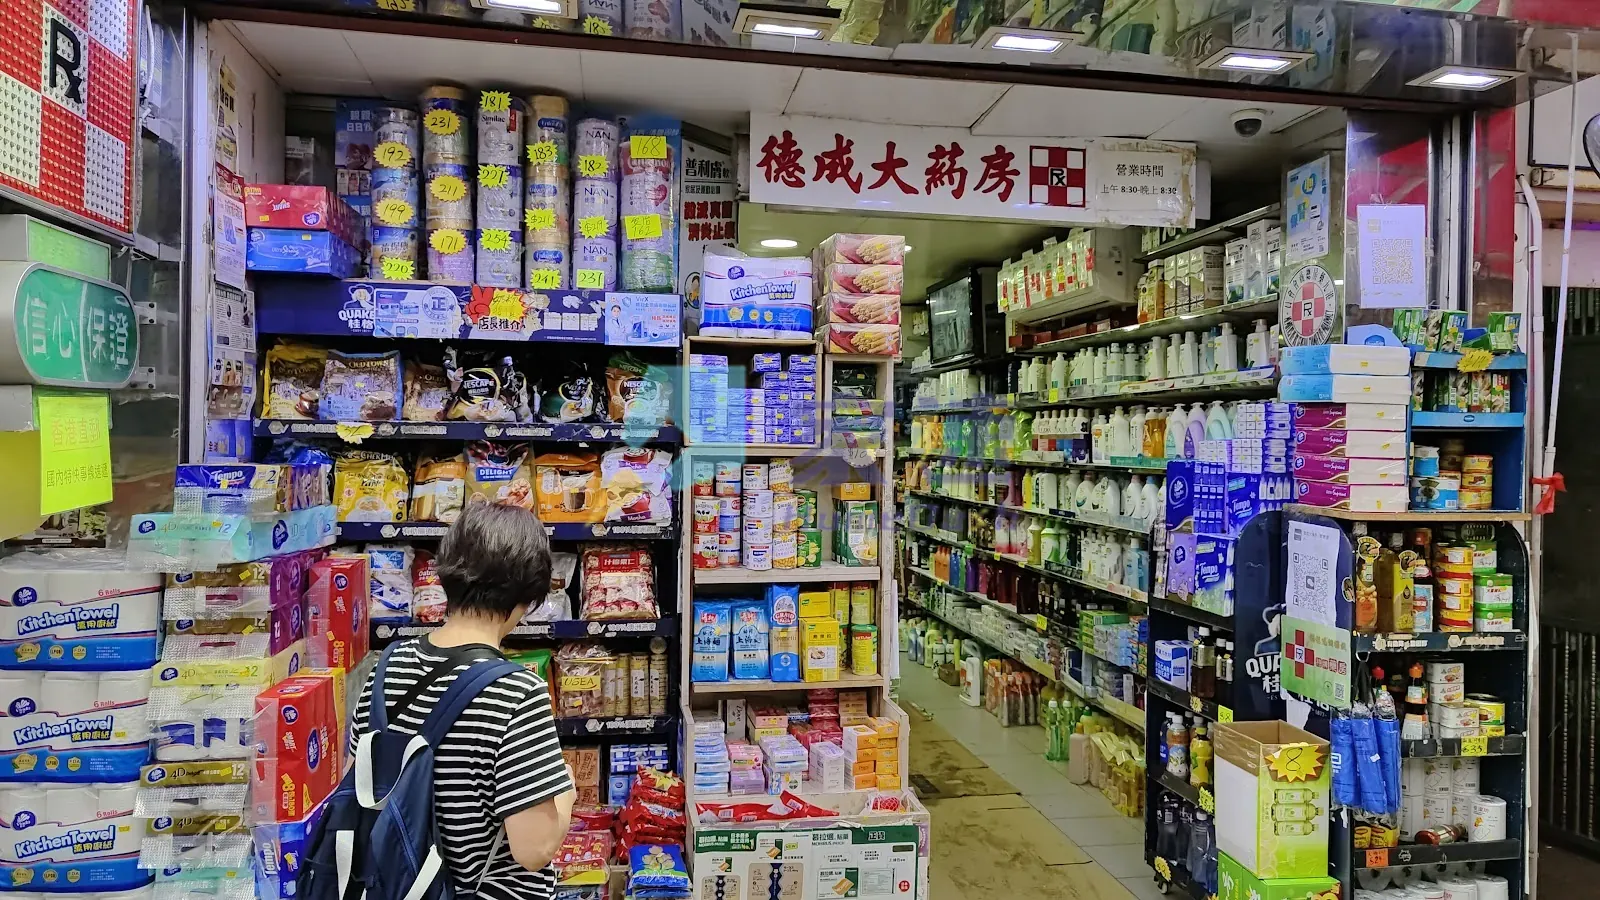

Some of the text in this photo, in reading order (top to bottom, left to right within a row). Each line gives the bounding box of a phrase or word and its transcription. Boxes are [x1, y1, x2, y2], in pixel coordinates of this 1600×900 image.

[484, 94, 501, 107] 181
[430, 116, 451, 128] 231
[481, 114, 505, 123] Similac
[586, 131, 611, 141] NAN
[534, 145, 553, 159] 183
[637, 137, 661, 157] 168
[382, 146, 407, 162] 192
[1116, 163, 1164, 178] 營業時間
[439, 184, 456, 196] 211
[584, 187, 609, 197] NAN
[1100, 184, 1120, 195] 上午
[383, 203, 406, 220] 199
[583, 245, 608, 255] NAN
[386, 264, 408, 274] 220
[338, 310, 374, 321] QUAKE
[23, 293, 129, 368] 信心保證
[211, 469, 243, 481] Tempo
[1231, 500, 1250, 512] Tempo
[253, 567, 265, 580] 12
[1200, 562, 1218, 575] Tempo
[18, 603, 119, 635] KitchenTowel
[14, 715, 113, 745] KitchenTowel
[1286, 747, 1304, 772] 8
[171, 763, 244, 779] 4D 12
[15, 825, 115, 858] KitchenTowel
[264, 842, 278, 875] Tempo
